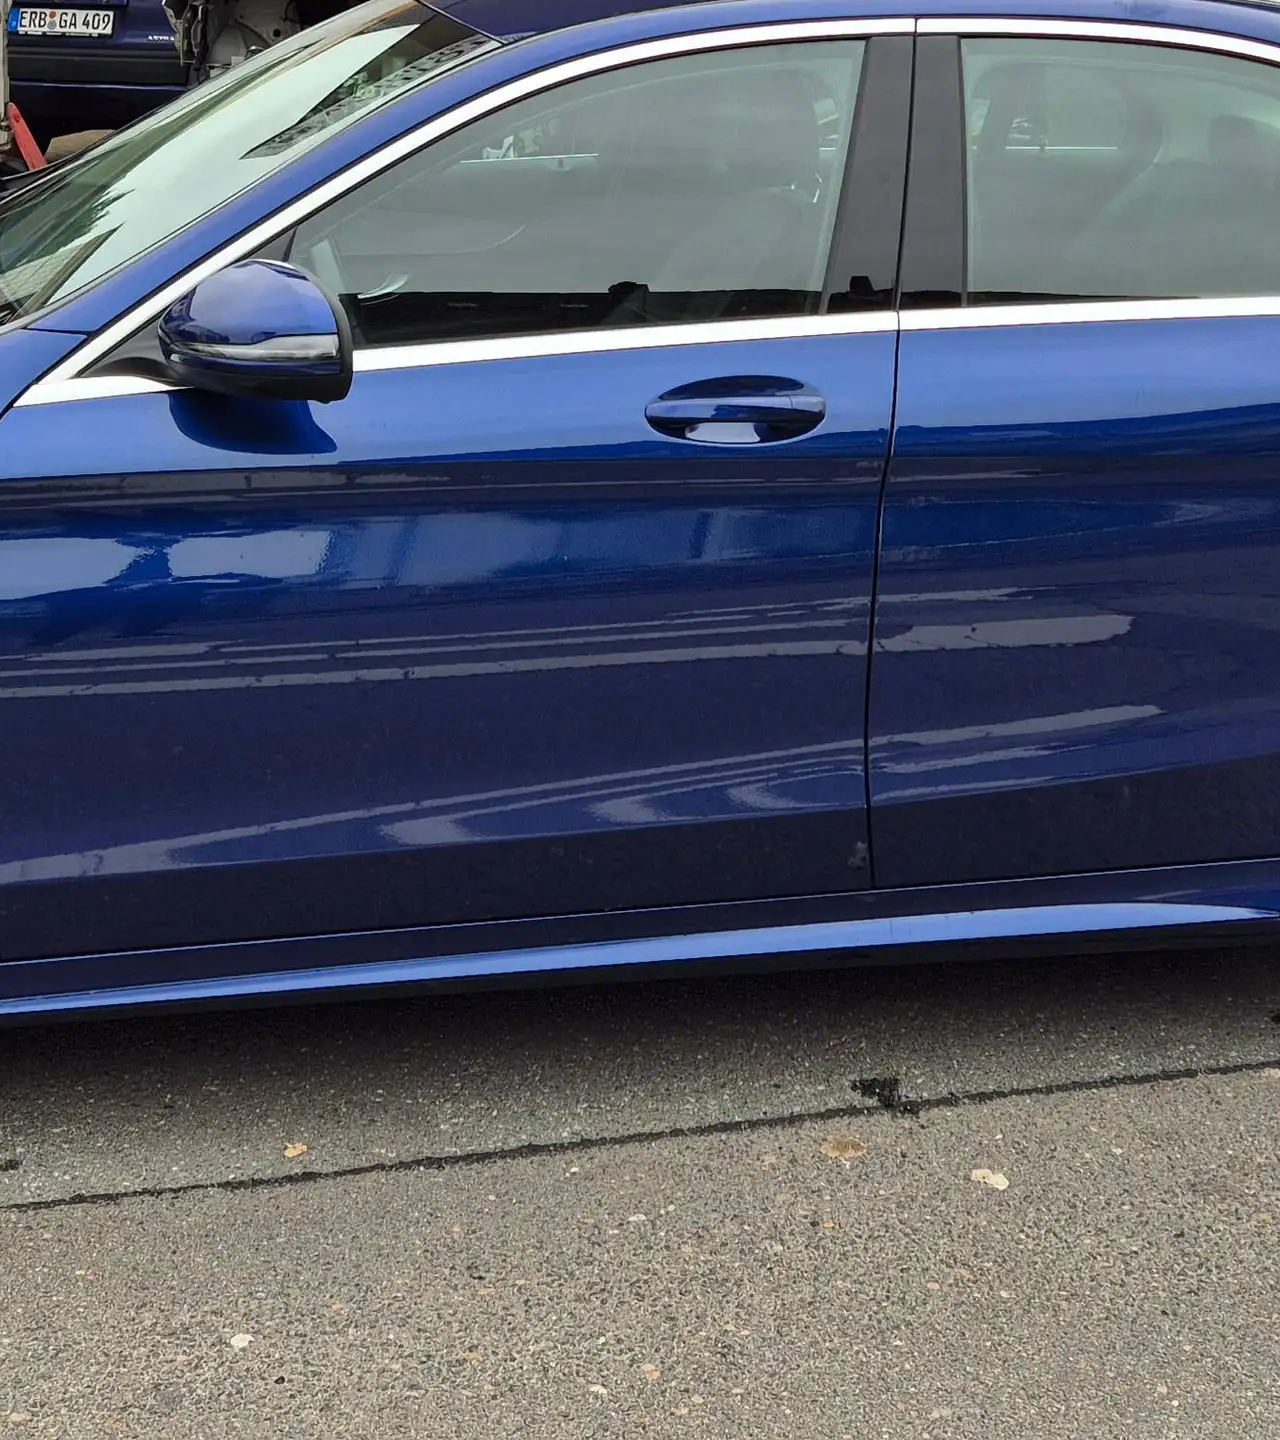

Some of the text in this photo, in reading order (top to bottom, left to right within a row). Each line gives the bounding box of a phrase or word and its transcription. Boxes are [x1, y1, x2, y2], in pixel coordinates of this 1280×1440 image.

[20, 10, 111, 31] ERB GA 409
